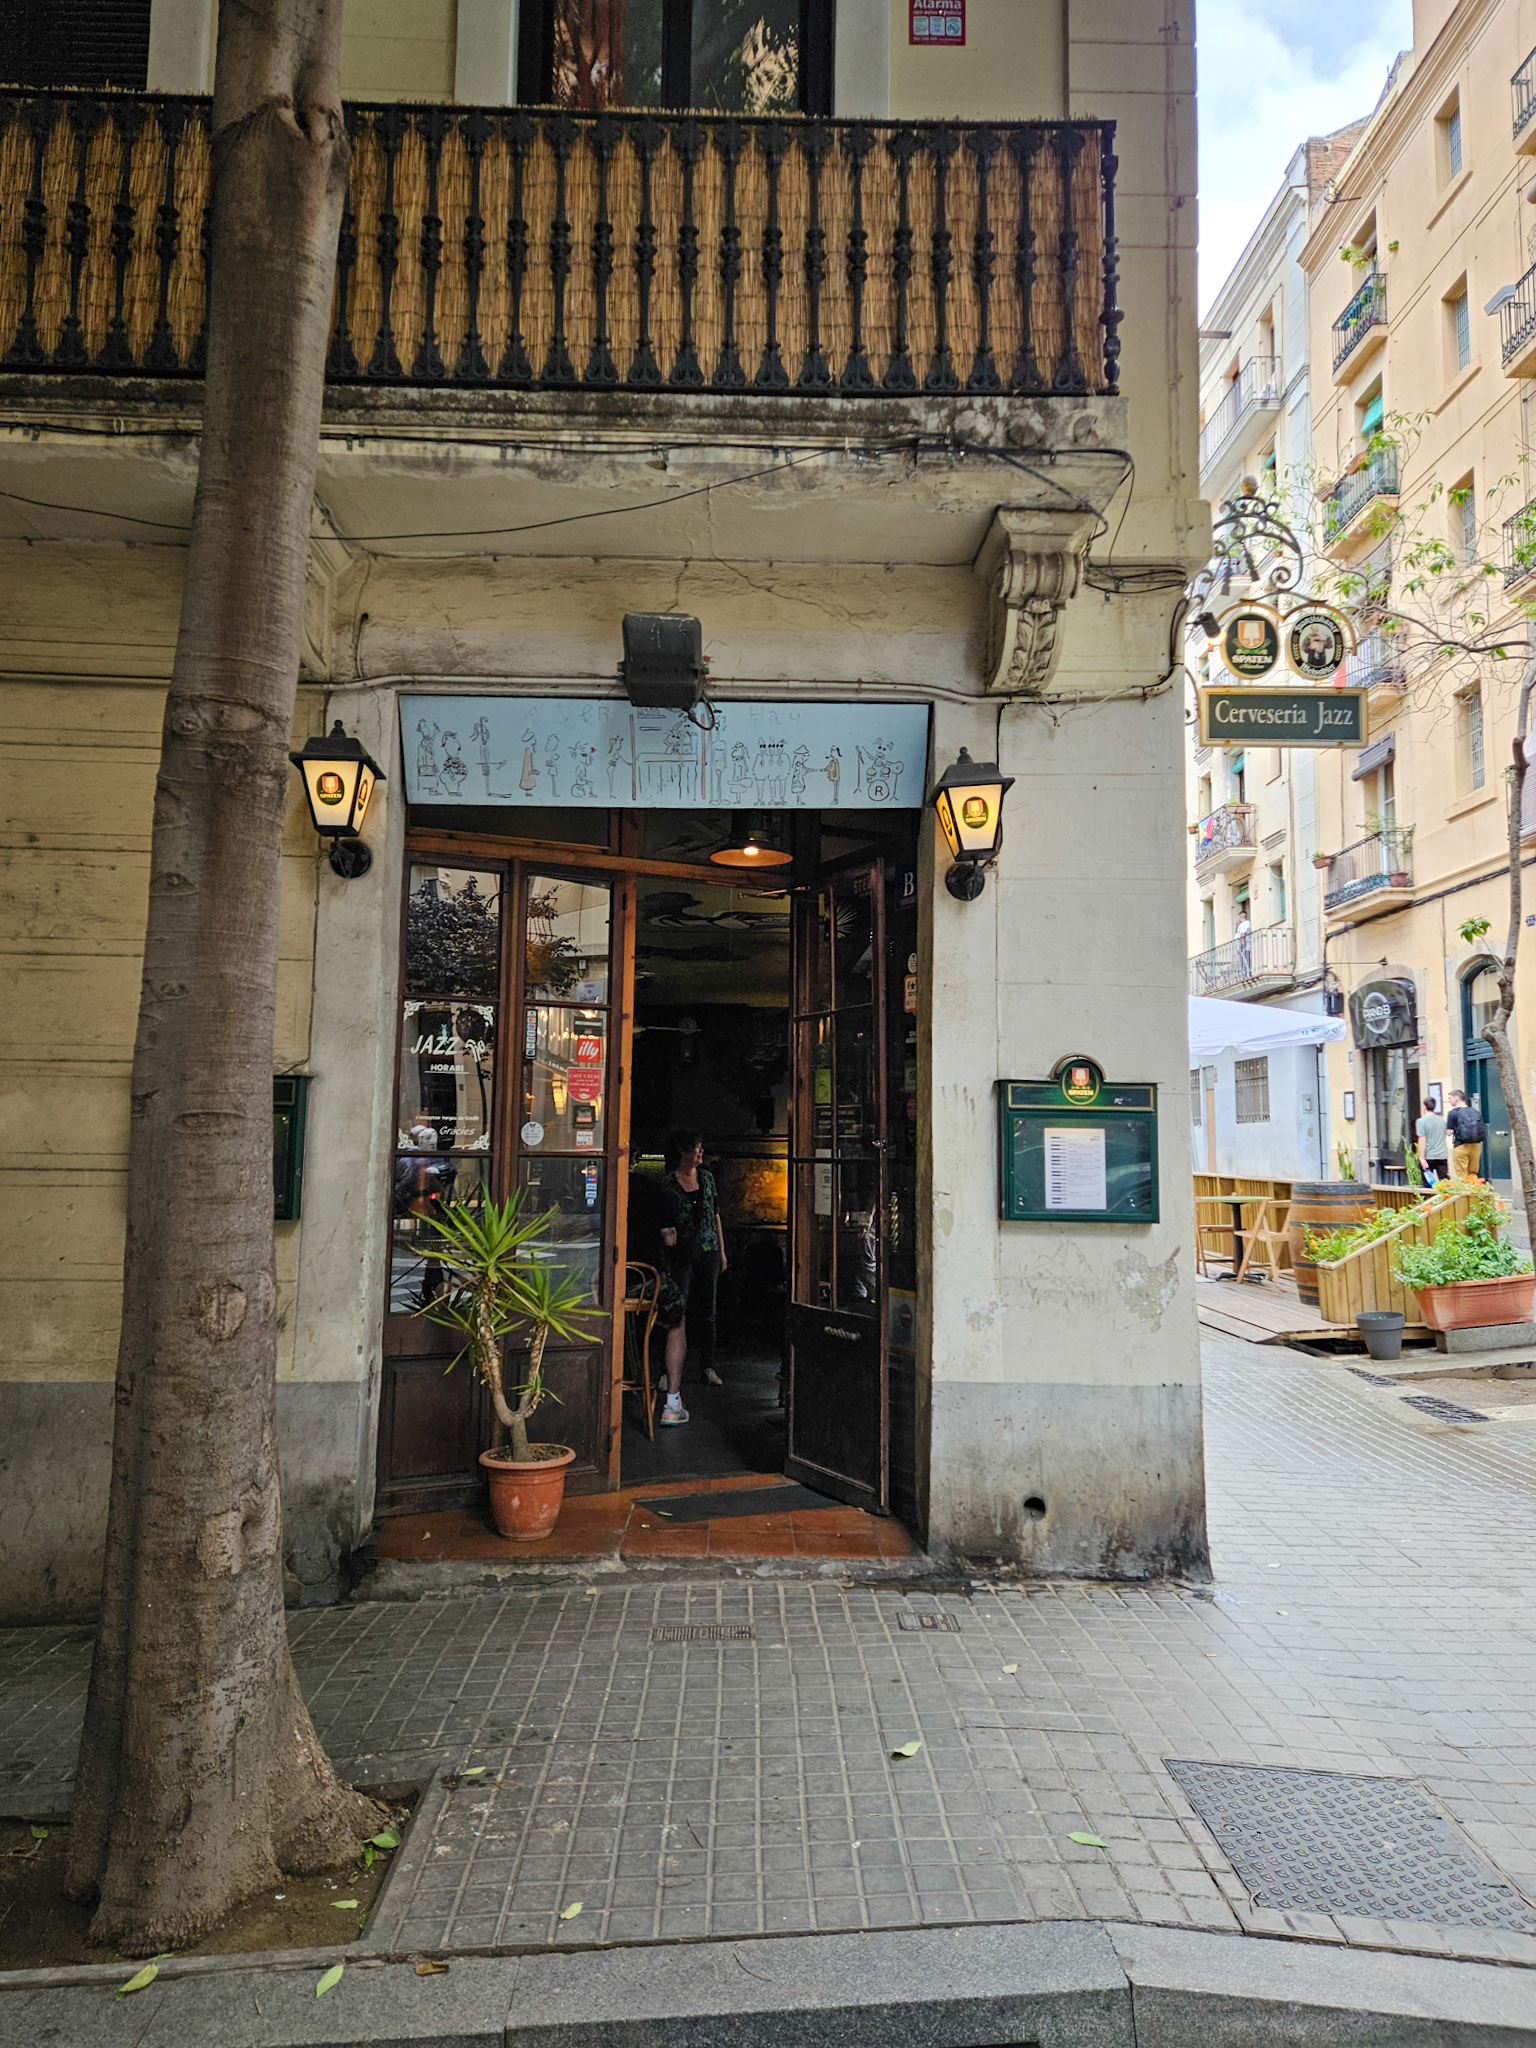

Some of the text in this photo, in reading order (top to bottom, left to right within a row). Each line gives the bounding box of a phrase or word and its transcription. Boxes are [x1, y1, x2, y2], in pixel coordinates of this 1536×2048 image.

[913, 0, 962, 9] Alarma
[1231, 655, 1273, 664] SPATEN
[1214, 700, 1354, 734] Cerveseria Jazz
[874, 785, 884, 797] R
[410, 1034, 462, 1056] JAZZ
[578, 1041, 600, 1060] illy
[430, 1064, 464, 1072] HORARI
